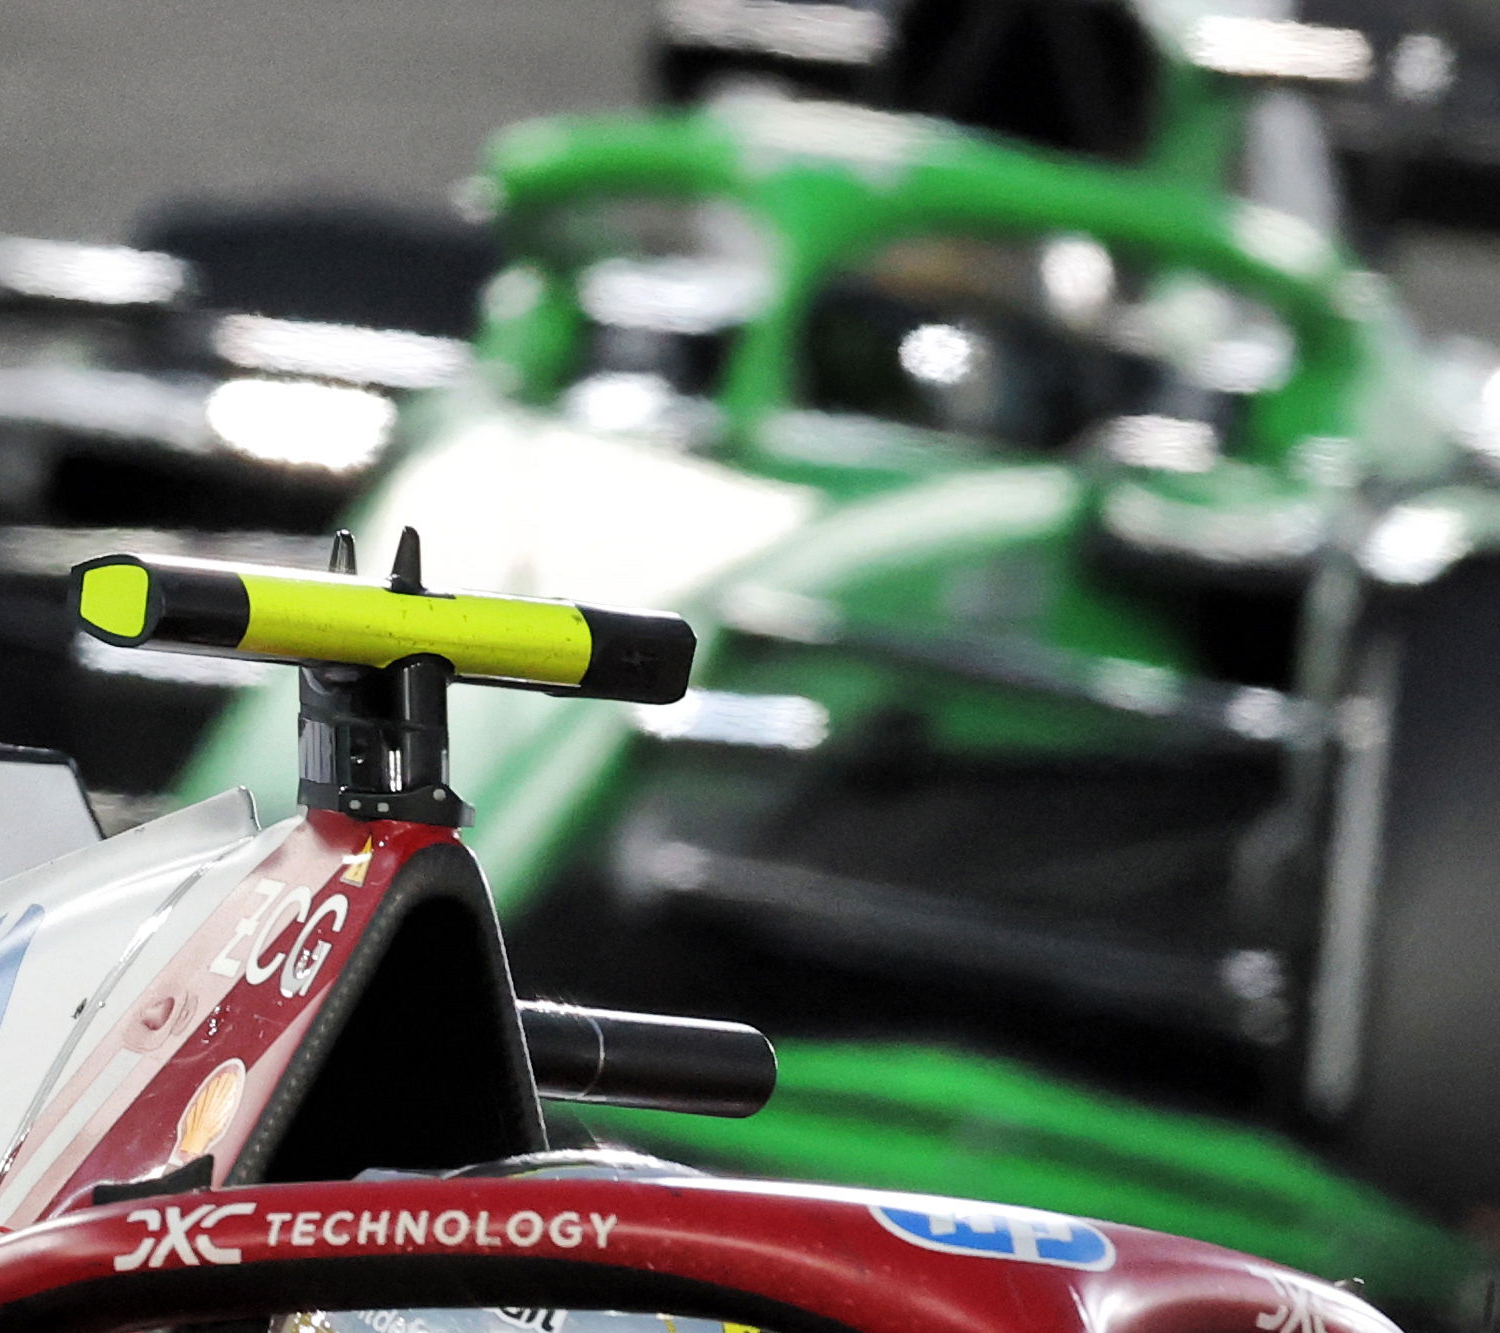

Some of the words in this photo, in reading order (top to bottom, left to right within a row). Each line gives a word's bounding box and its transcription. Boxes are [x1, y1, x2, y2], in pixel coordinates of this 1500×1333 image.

[208, 877, 350, 999] ZCG
[112, 1202, 258, 1272] DXC
[265, 1208, 619, 1251] TECHNOLOGY
